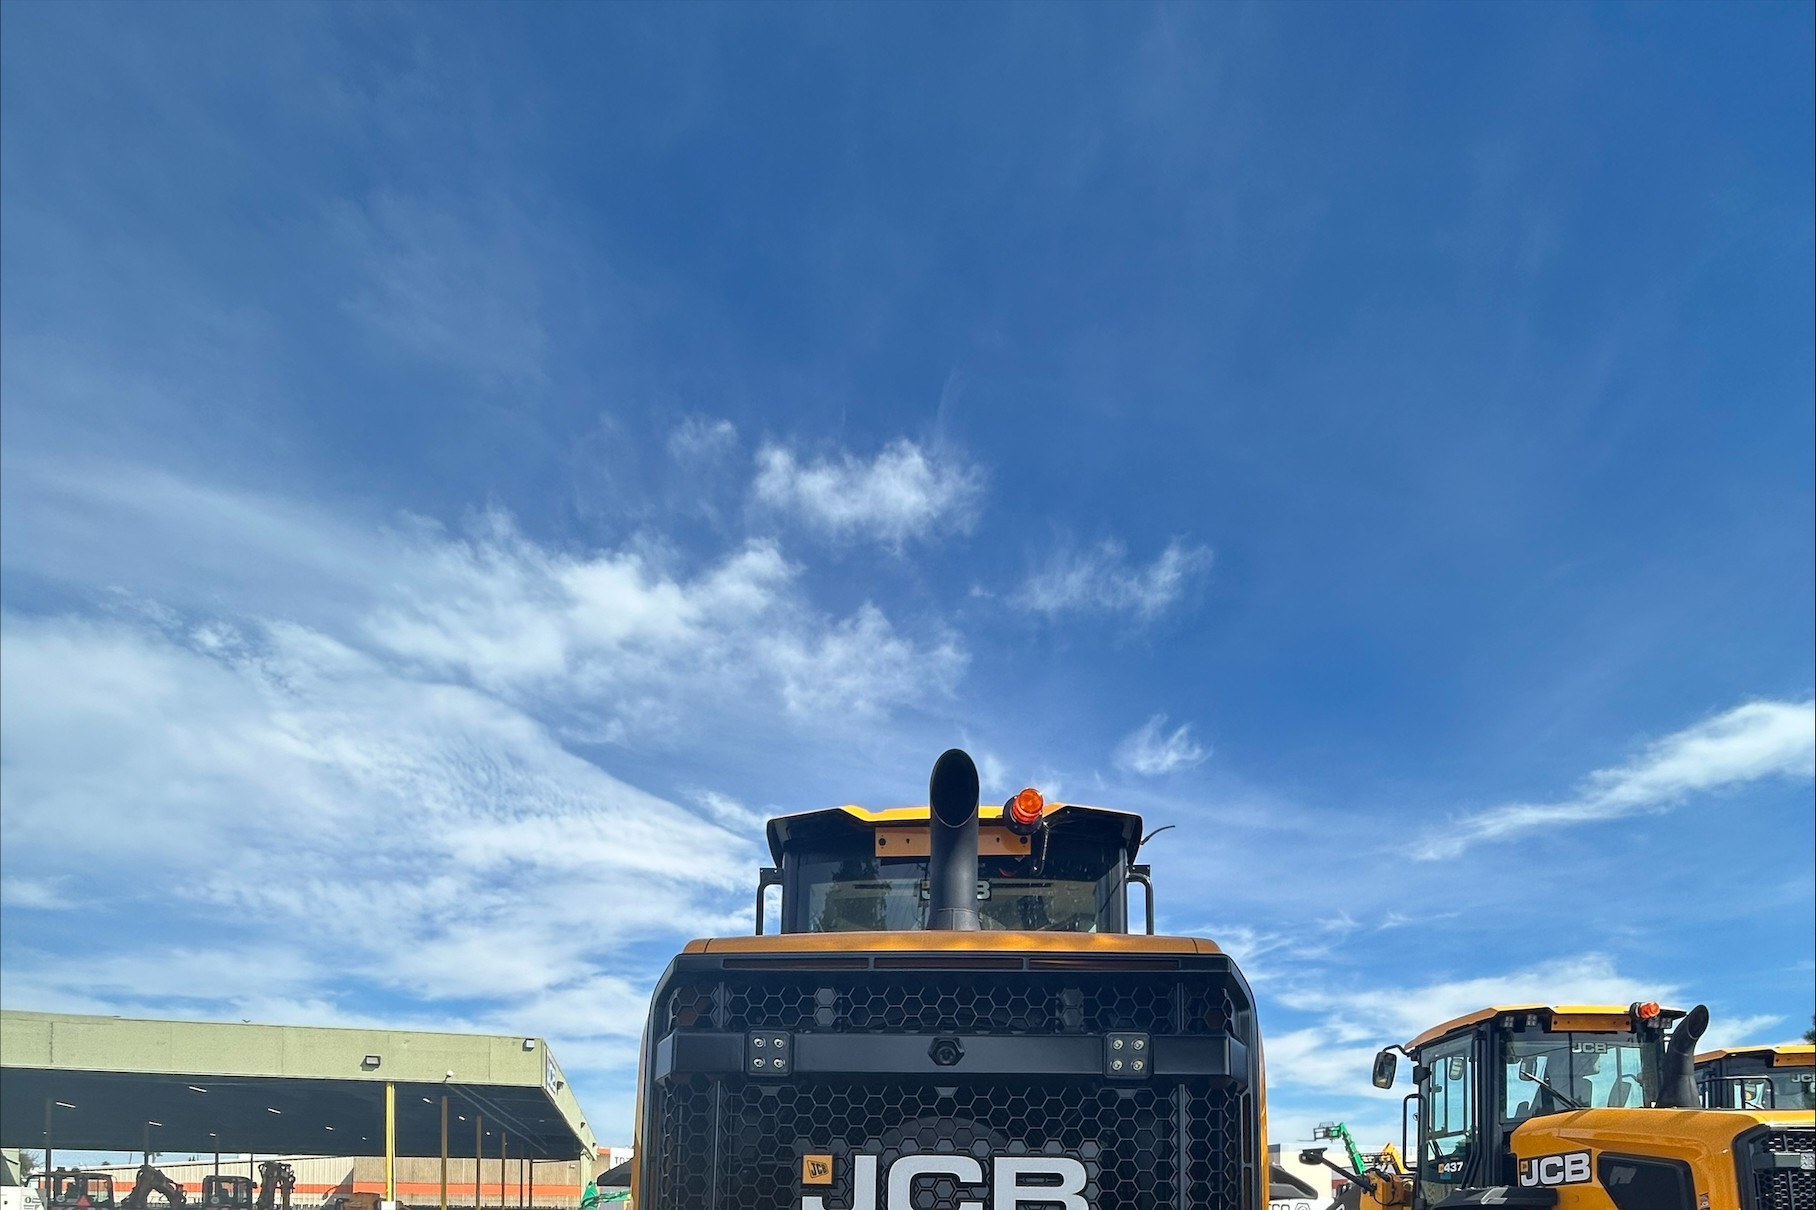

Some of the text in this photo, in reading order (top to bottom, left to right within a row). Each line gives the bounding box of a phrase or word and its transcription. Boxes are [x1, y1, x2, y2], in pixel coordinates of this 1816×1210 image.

[1571, 1042, 1607, 1053] JCB
[1791, 1074, 1815, 1083] JC
[614, 1157, 632, 1165] TO
[1443, 1161, 1464, 1173] 437
[1520, 1153, 1591, 1187] JCB
